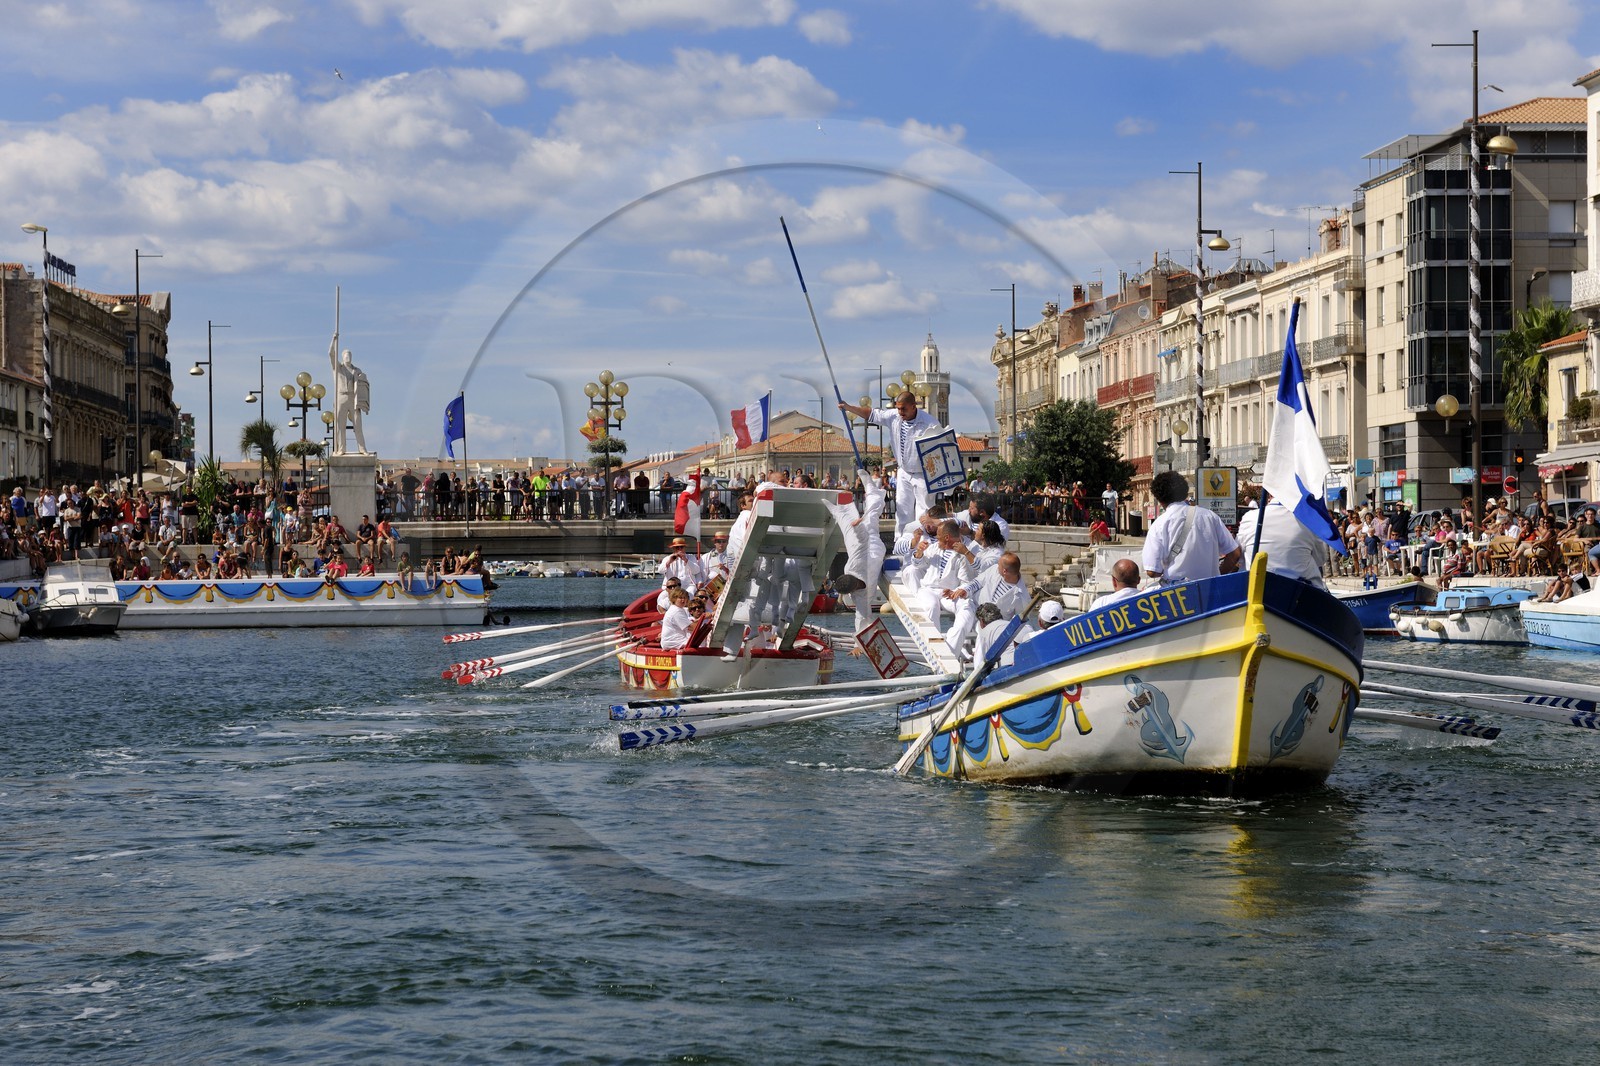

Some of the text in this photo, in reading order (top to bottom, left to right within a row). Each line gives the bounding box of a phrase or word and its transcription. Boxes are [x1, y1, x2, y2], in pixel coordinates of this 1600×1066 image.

[937, 476, 956, 487] SETE
[1064, 586, 1195, 647] VILLE DE SETE
